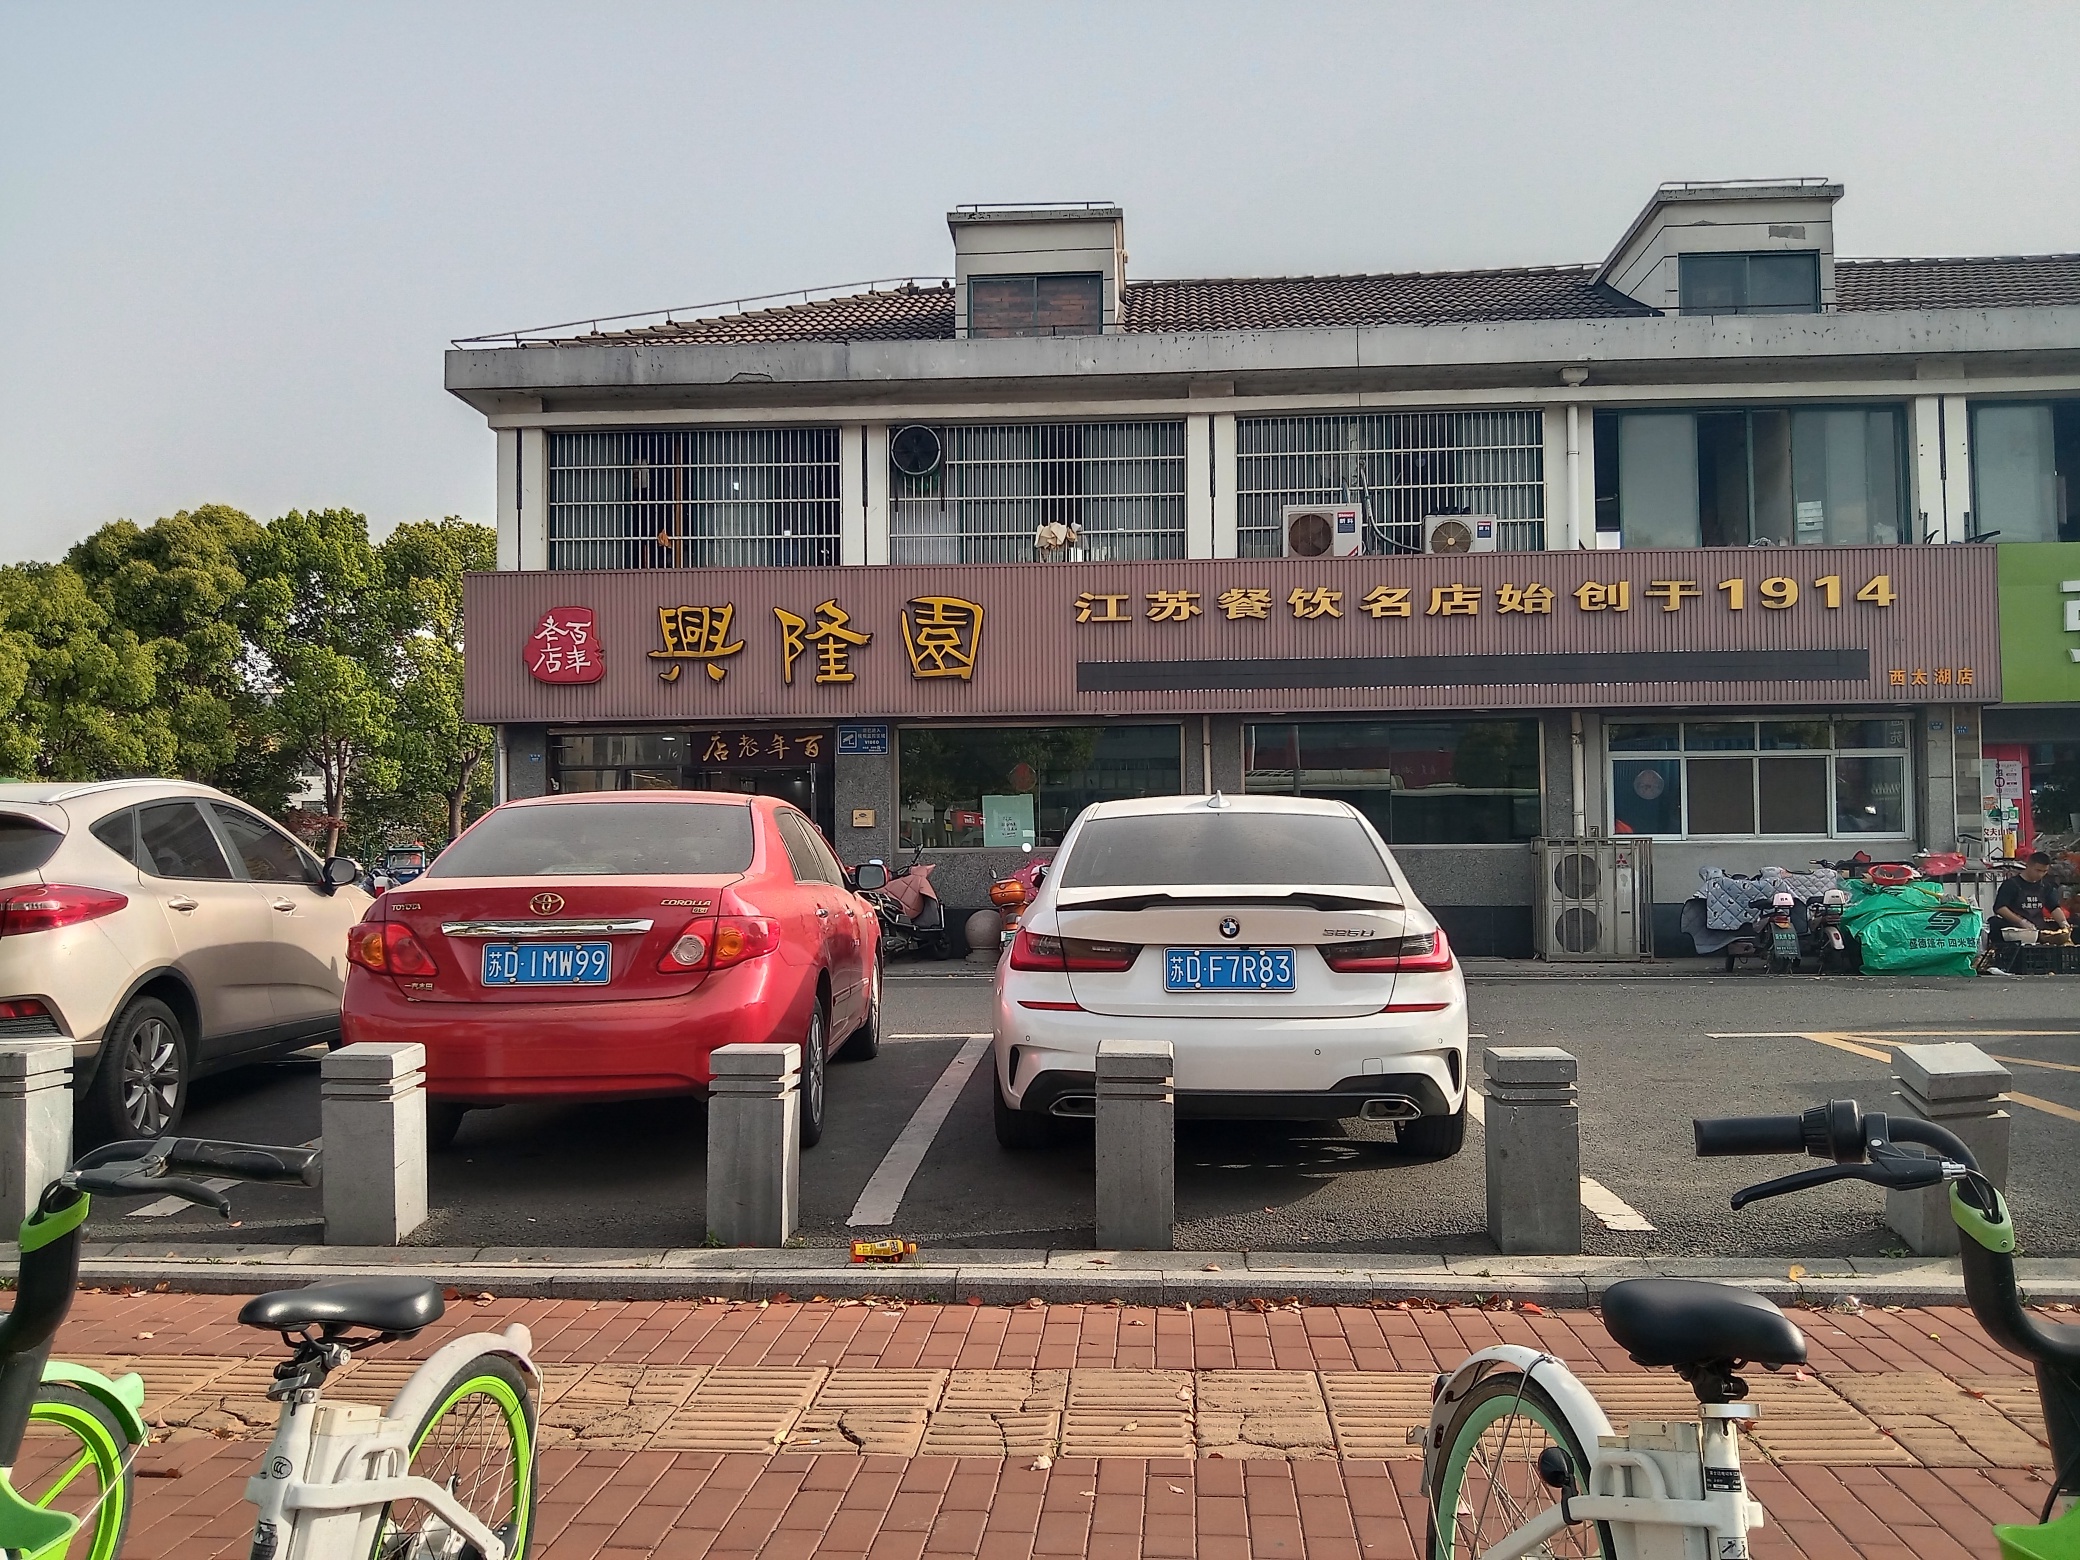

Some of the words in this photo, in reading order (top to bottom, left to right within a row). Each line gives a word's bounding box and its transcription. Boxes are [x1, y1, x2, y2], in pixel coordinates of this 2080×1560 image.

[1073, 576, 1897, 624] 江苏餐饮名店始创于1914
[1888, 667, 1974, 686] 西太湖店
[391, 903, 421, 911] TOYOTA
[660, 898, 712, 907] COROLLA
